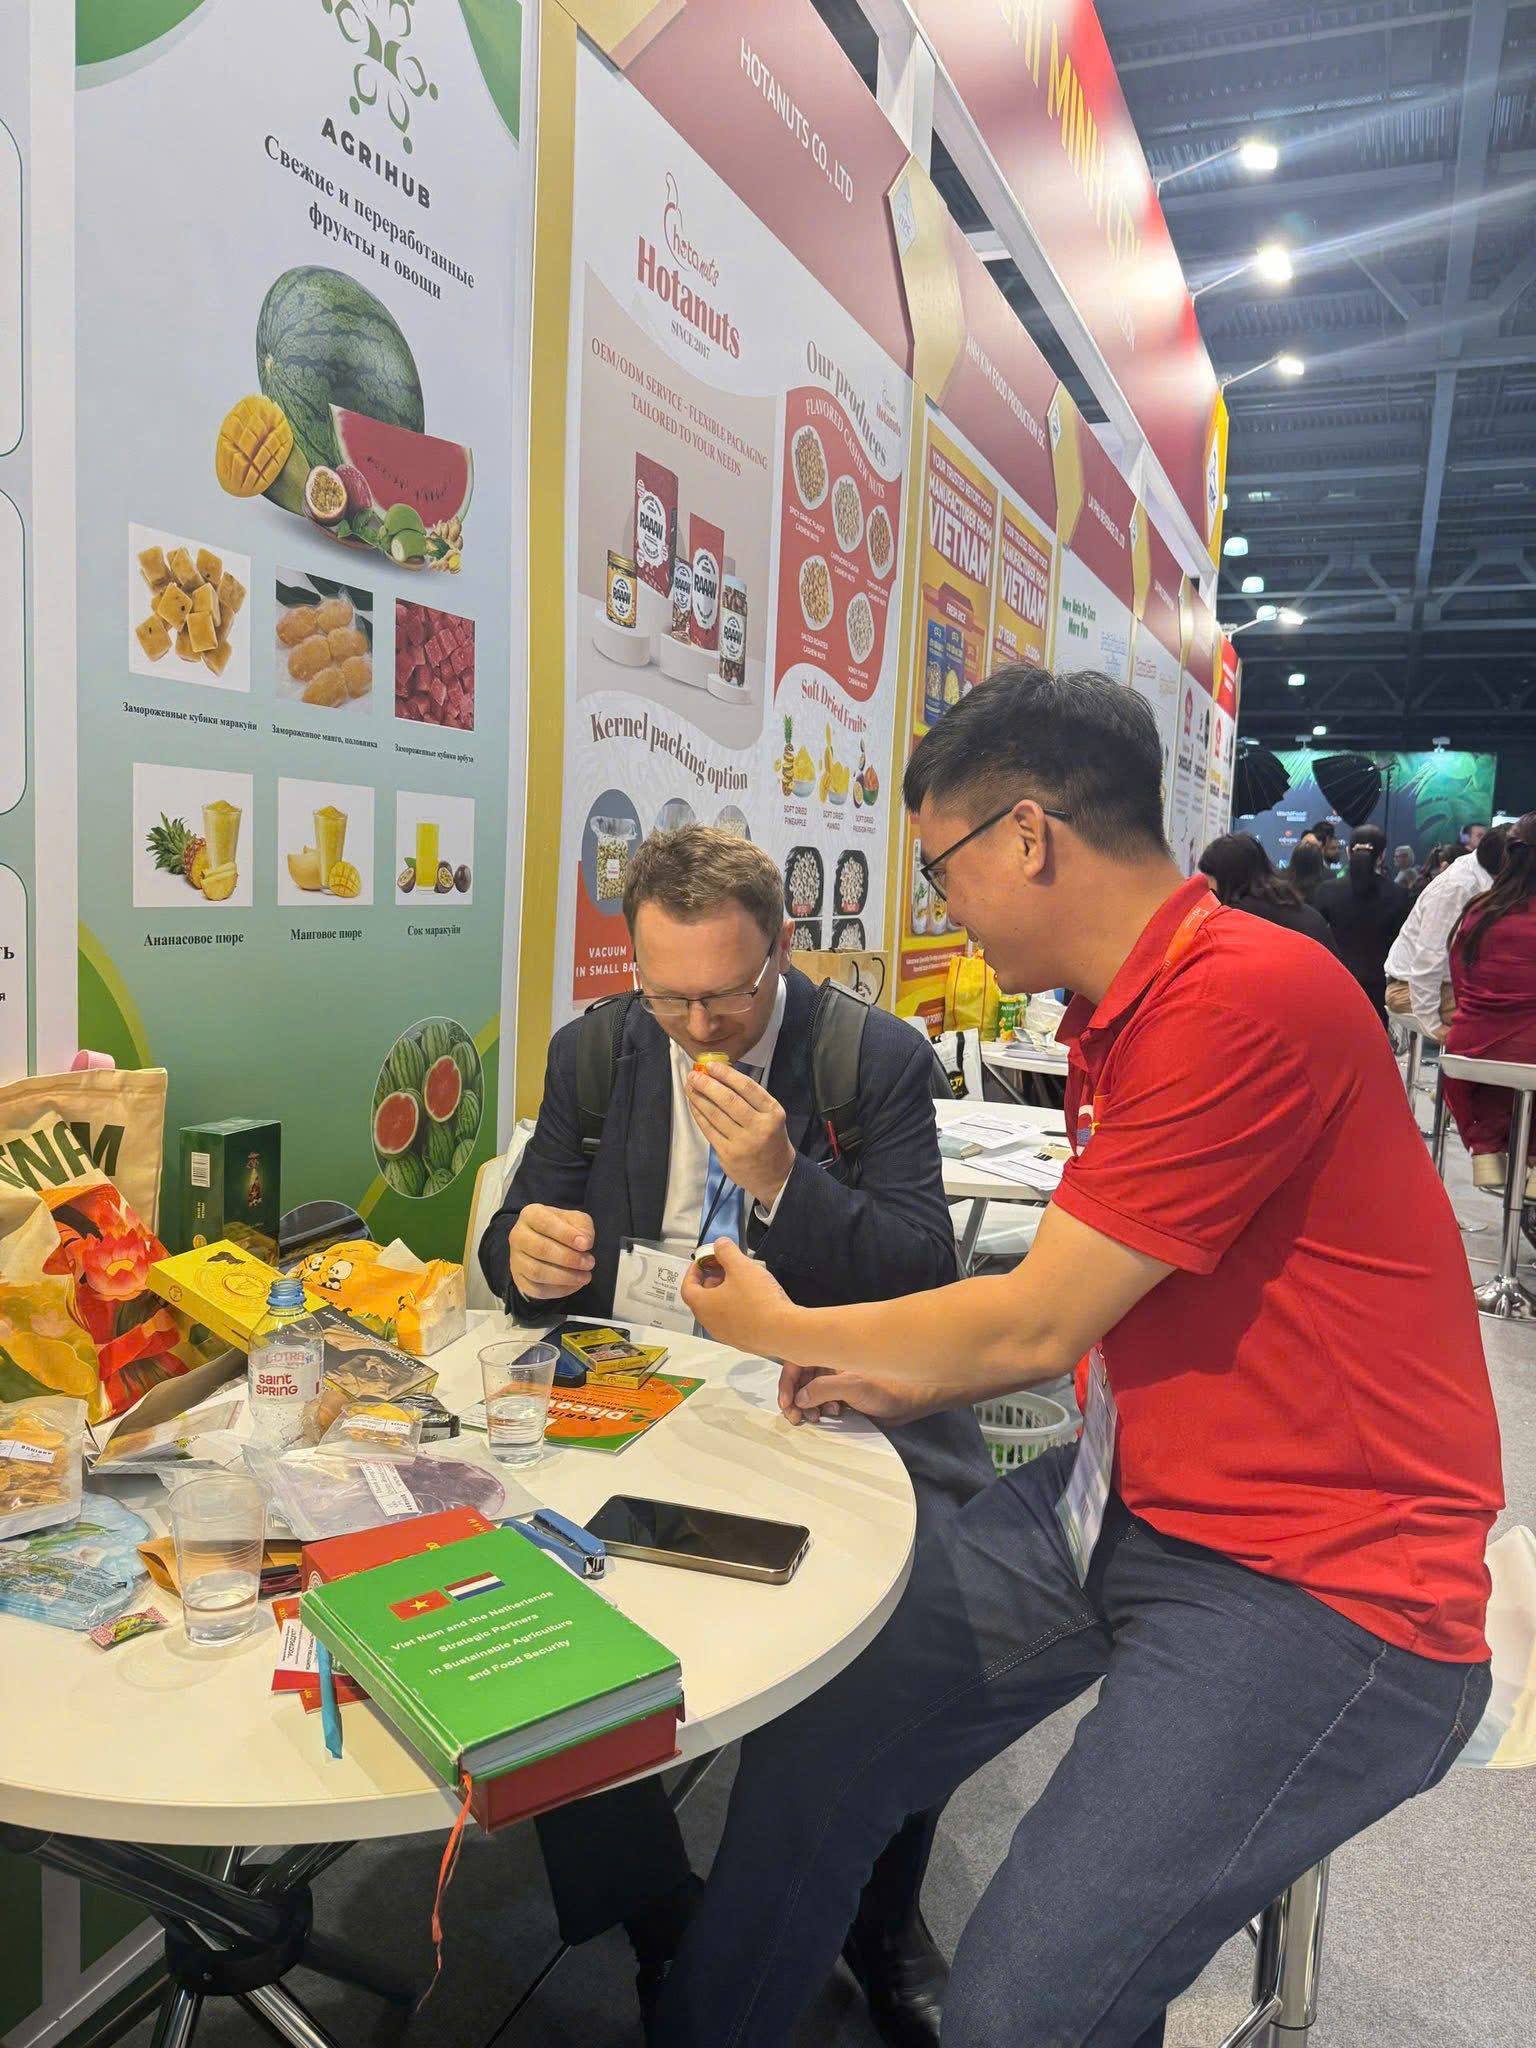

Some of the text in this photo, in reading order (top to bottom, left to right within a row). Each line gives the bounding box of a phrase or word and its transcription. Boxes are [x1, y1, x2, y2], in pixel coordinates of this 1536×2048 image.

[740, 37, 854, 203] HOTANUTS CO., LTD
[321, 117, 431, 209] AGRIHUB
[264, 134, 475, 289] Свежие и переработанные
[308, 201, 441, 301] фрукты и овощи
[637, 235, 740, 359] Hotanuts
[671, 319, 711, 360] SINCE 2017
[806, 340, 834, 381] Our
[591, 337, 644, 386] OEM/ODM
[646, 375, 683, 412] SERVICE
[688, 403, 726, 442] FLEXIBLE
[727, 430, 768, 470] PACKAGING
[992, 367, 1008, 400] FOOD
[631, 392, 741, 477] TAILORED TO YOUR NEEDS
[805, 399, 885, 499] FLAVORED CASHEW NUTS
[928, 474, 992, 544] MANUFACTURER FROM
[929, 496, 991, 587] VIETNAM
[1002, 557, 1048, 629] VIETNAM
[122, 701, 188, 721] Замороженные
[189, 711, 219, 725] кубики
[271, 724, 321, 741] Замороженное
[801, 678, 867, 733] Soft Dried Fruits
[590, 711, 748, 794] Kernel packing option
[144, 932, 244, 947] Ананасовое пюре
[290, 928, 363, 941] Манговое пюре
[407, 925, 423, 937] Сок
[588, 945, 627, 958] VACUUM
[575, 966, 586, 977] IN
[589, 963, 620, 976] SMALL
[390, 1590, 554, 1652] Viet Nam and the Netherlands
[438, 1612, 540, 1653] Strategic Partners
[442, 1641, 511, 1671] Sustainable
[512, 1619, 573, 1646] Agriculture
[467, 1638, 571, 1681] and Food Security
